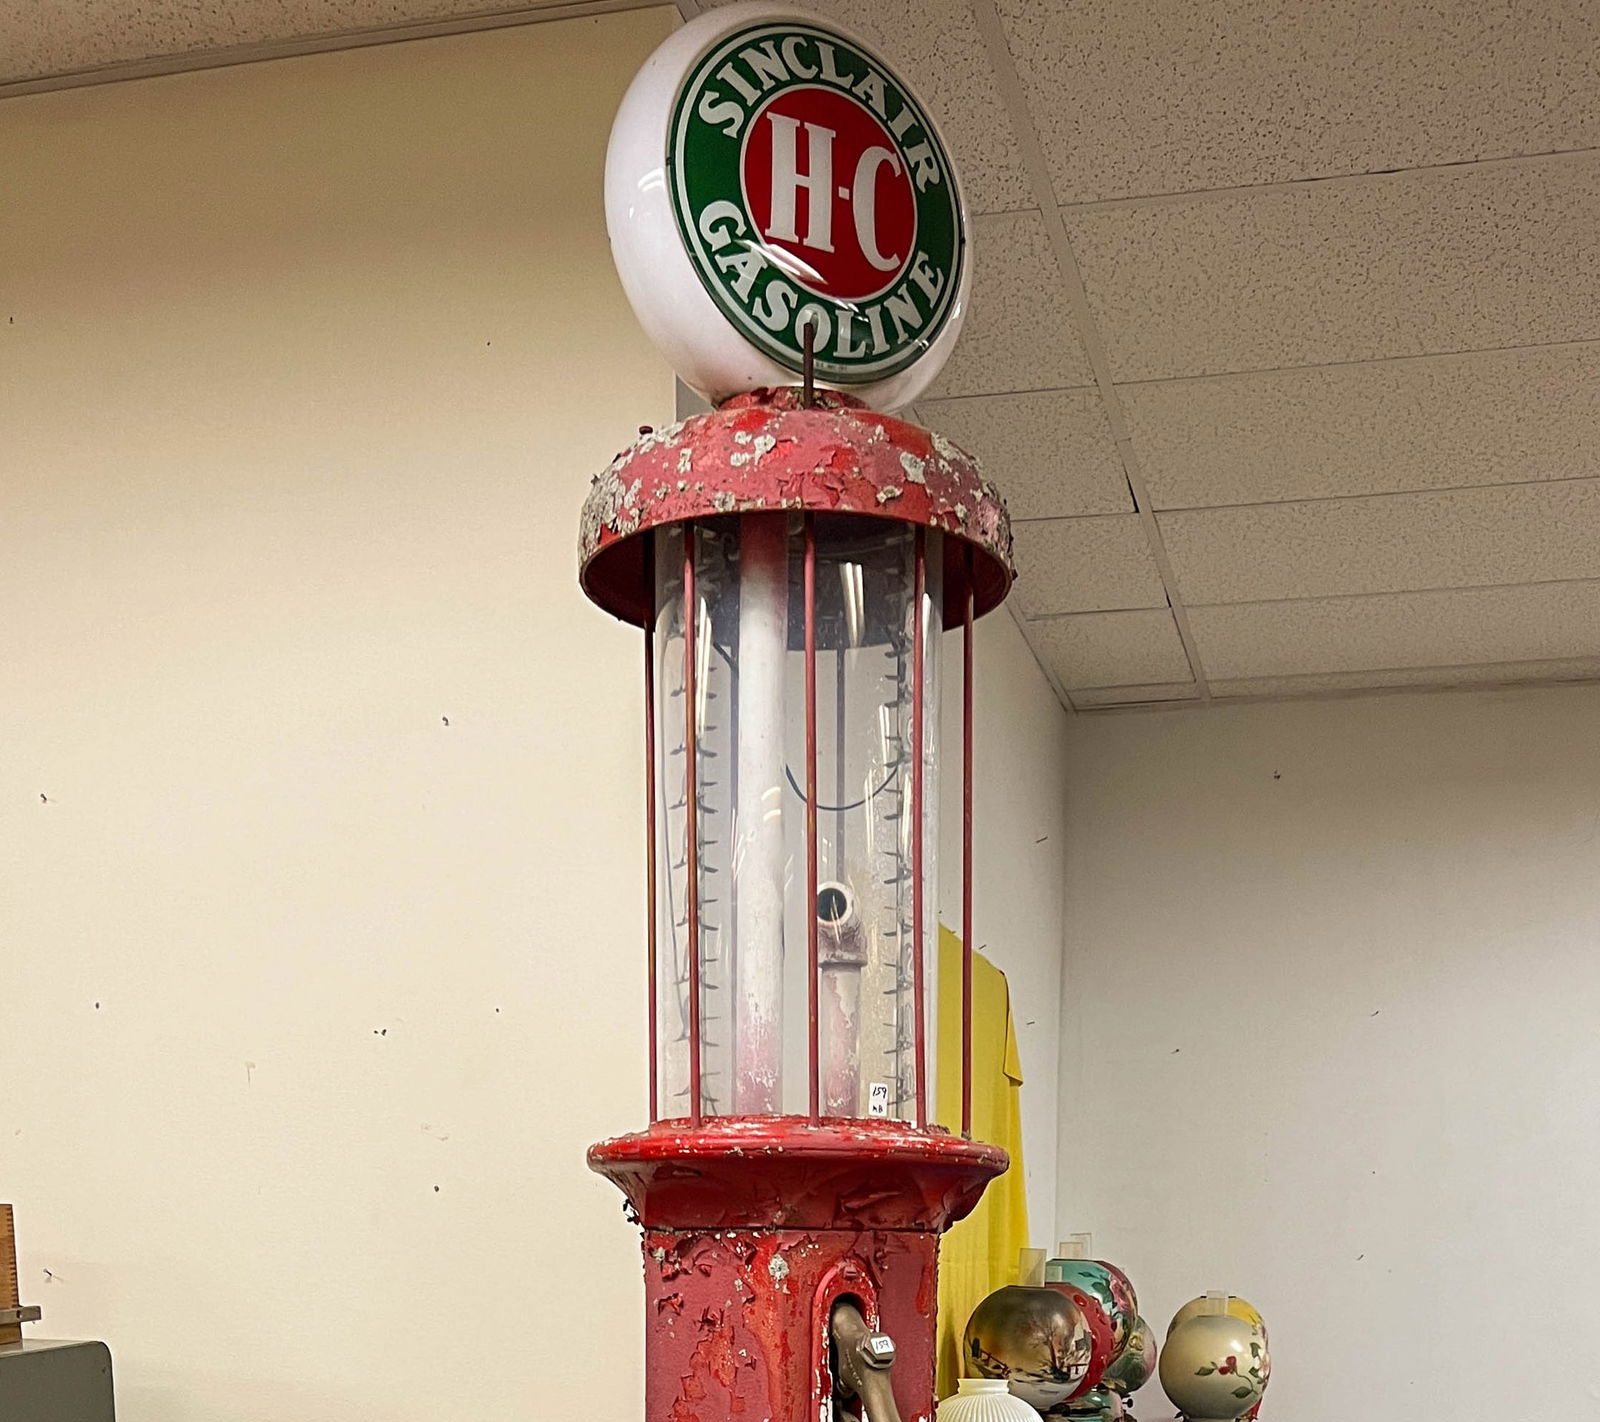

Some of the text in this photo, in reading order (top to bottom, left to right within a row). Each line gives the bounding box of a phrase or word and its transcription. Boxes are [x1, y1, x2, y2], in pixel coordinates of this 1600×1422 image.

[698, 35, 941, 194] SINCLAIR
[764, 111, 902, 273] H-C
[698, 199, 945, 359] GASOLINE
[872, 1086, 887, 1099] 159
[875, 1339, 890, 1350] 159
